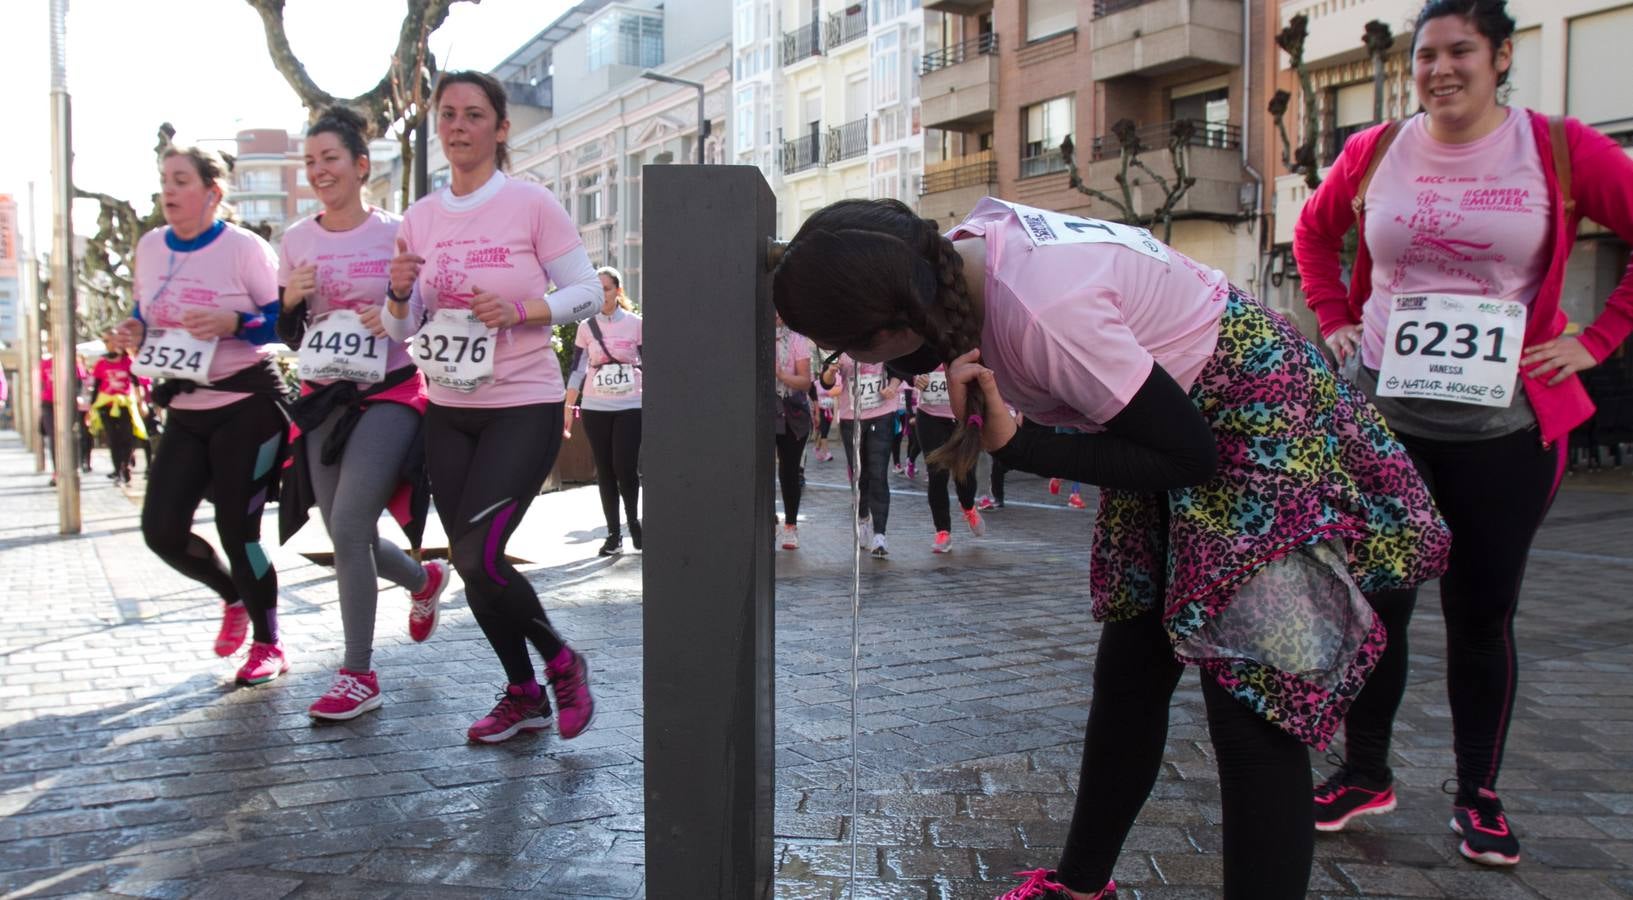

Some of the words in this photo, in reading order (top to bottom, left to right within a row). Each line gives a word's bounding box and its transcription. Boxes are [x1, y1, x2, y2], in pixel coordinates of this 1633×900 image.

[1416, 176, 1446, 184] AECC
[307, 330, 378, 359] 4491
[419, 333, 488, 363] 3276
[1395, 320, 1508, 363] 6231
[139, 345, 203, 373] 3524
[1429, 363, 1463, 375] VANESSA
[597, 373, 631, 386] 1601
[852, 380, 882, 396] 717
[1401, 379, 1442, 390] NATUR
[1446, 381, 1489, 396] HOUSE
